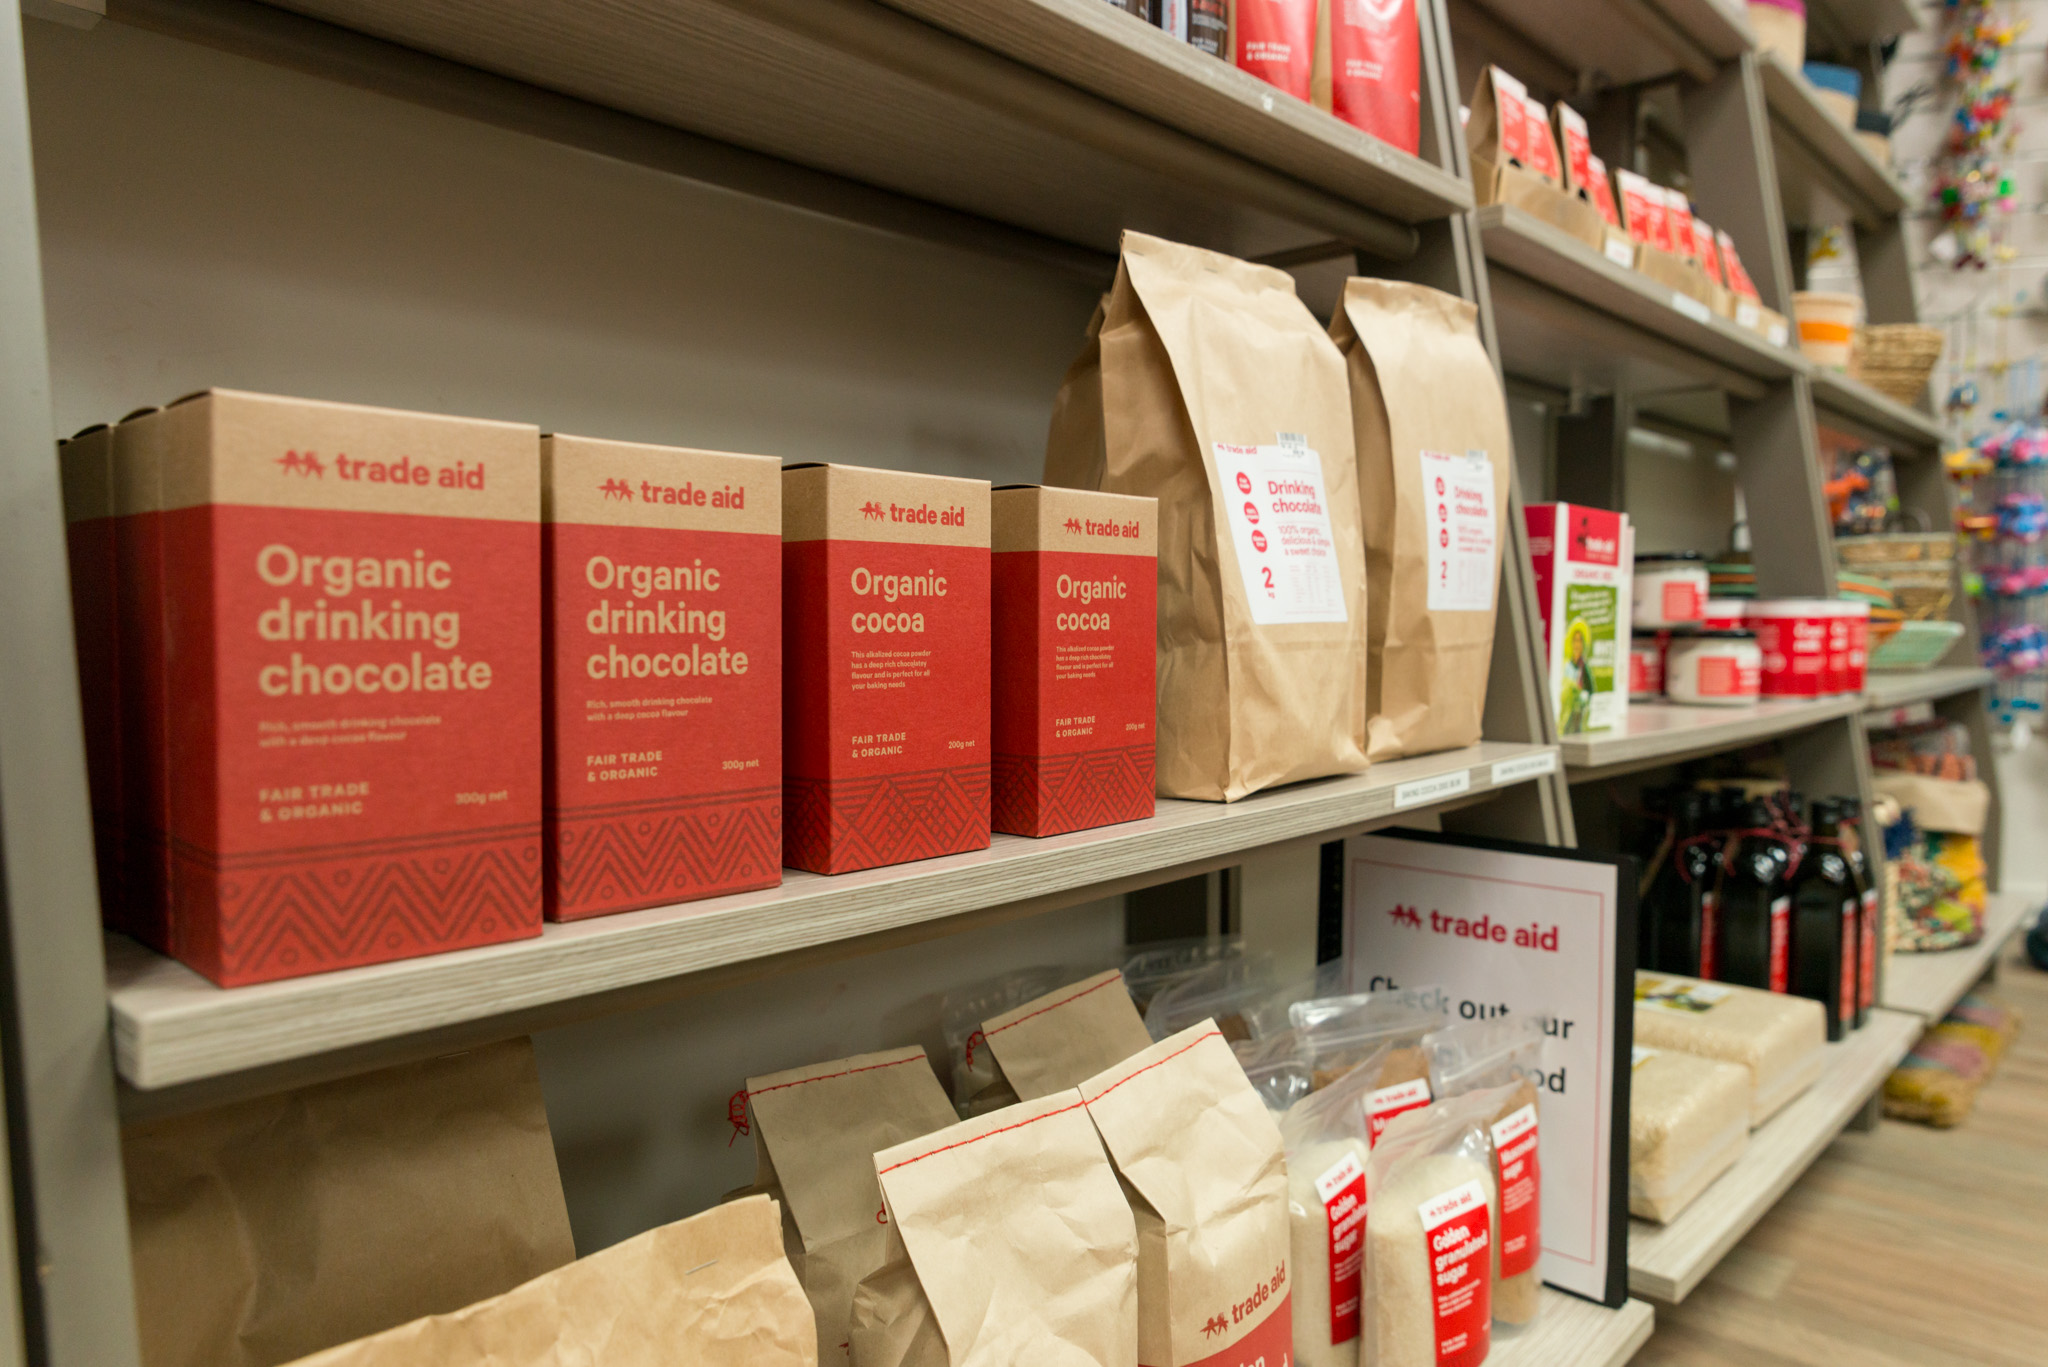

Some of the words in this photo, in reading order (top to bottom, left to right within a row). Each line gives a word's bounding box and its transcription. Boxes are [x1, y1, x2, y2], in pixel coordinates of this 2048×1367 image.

[336, 453, 430, 485] trade
[438, 461, 485, 490] aid
[641, 481, 706, 506] trade
[712, 485, 744, 509] aid
[1268, 480, 1315, 499] Drinking
[890, 503, 937, 524] trade
[941, 506, 964, 526] aid
[1086, 519, 1119, 537] trade
[1122, 521, 1139, 538] aid
[257, 544, 451, 596] Organic
[586, 556, 720, 598] Organic
[1262, 567, 1274, 588] 2
[1441, 561, 1446, 579] 2
[851, 567, 947, 602] Organic
[1057, 574, 1126, 604] Organic
[258, 597, 459, 649] drinking
[587, 600, 725, 641] drinking
[852, 613, 924, 633] cocoa
[1057, 613, 1110, 630] cocoa
[587, 644, 748, 679] chocolate
[869, 661, 883, 669] deep
[259, 652, 491, 696] chocolate
[893, 671, 913, 679] perfect
[867, 682, 887, 690] baking
[610, 699, 640, 708] smooth
[642, 698, 674, 706] drinking
[676, 696, 712, 704] chocolate
[587, 713, 605, 721] with
[614, 712, 635, 720] deep
[662, 709, 688, 717] flavour
[1074, 716, 1095, 725] TRADE
[852, 735, 873, 744] FAIR
[876, 732, 906, 742] TRADE
[1063, 728, 1093, 736] ORGANIC
[852, 749, 858, 758] &
[861, 746, 902, 756] ORGANIC
[949, 741, 964, 749] 200g
[587, 755, 616, 766] FAIR
[621, 751, 663, 763] TRADE
[722, 761, 744, 770] 300g
[746, 759, 759, 768] net
[588, 772, 596, 782] &
[600, 767, 658, 780] ORGANIC
[259, 787, 302, 802] FAIR
[309, 782, 369, 797] TRADE
[260, 809, 273, 822] &
[278, 801, 363, 822] ORGANIC
[1430, 910, 1507, 942] trade
[1514, 923, 1559, 952] aid
[1433, 1225, 1470, 1251] Golden
[1437, 1262, 1468, 1286] sugar
[1232, 1282, 1268, 1324] trade
[1271, 1258, 1285, 1293] aid
